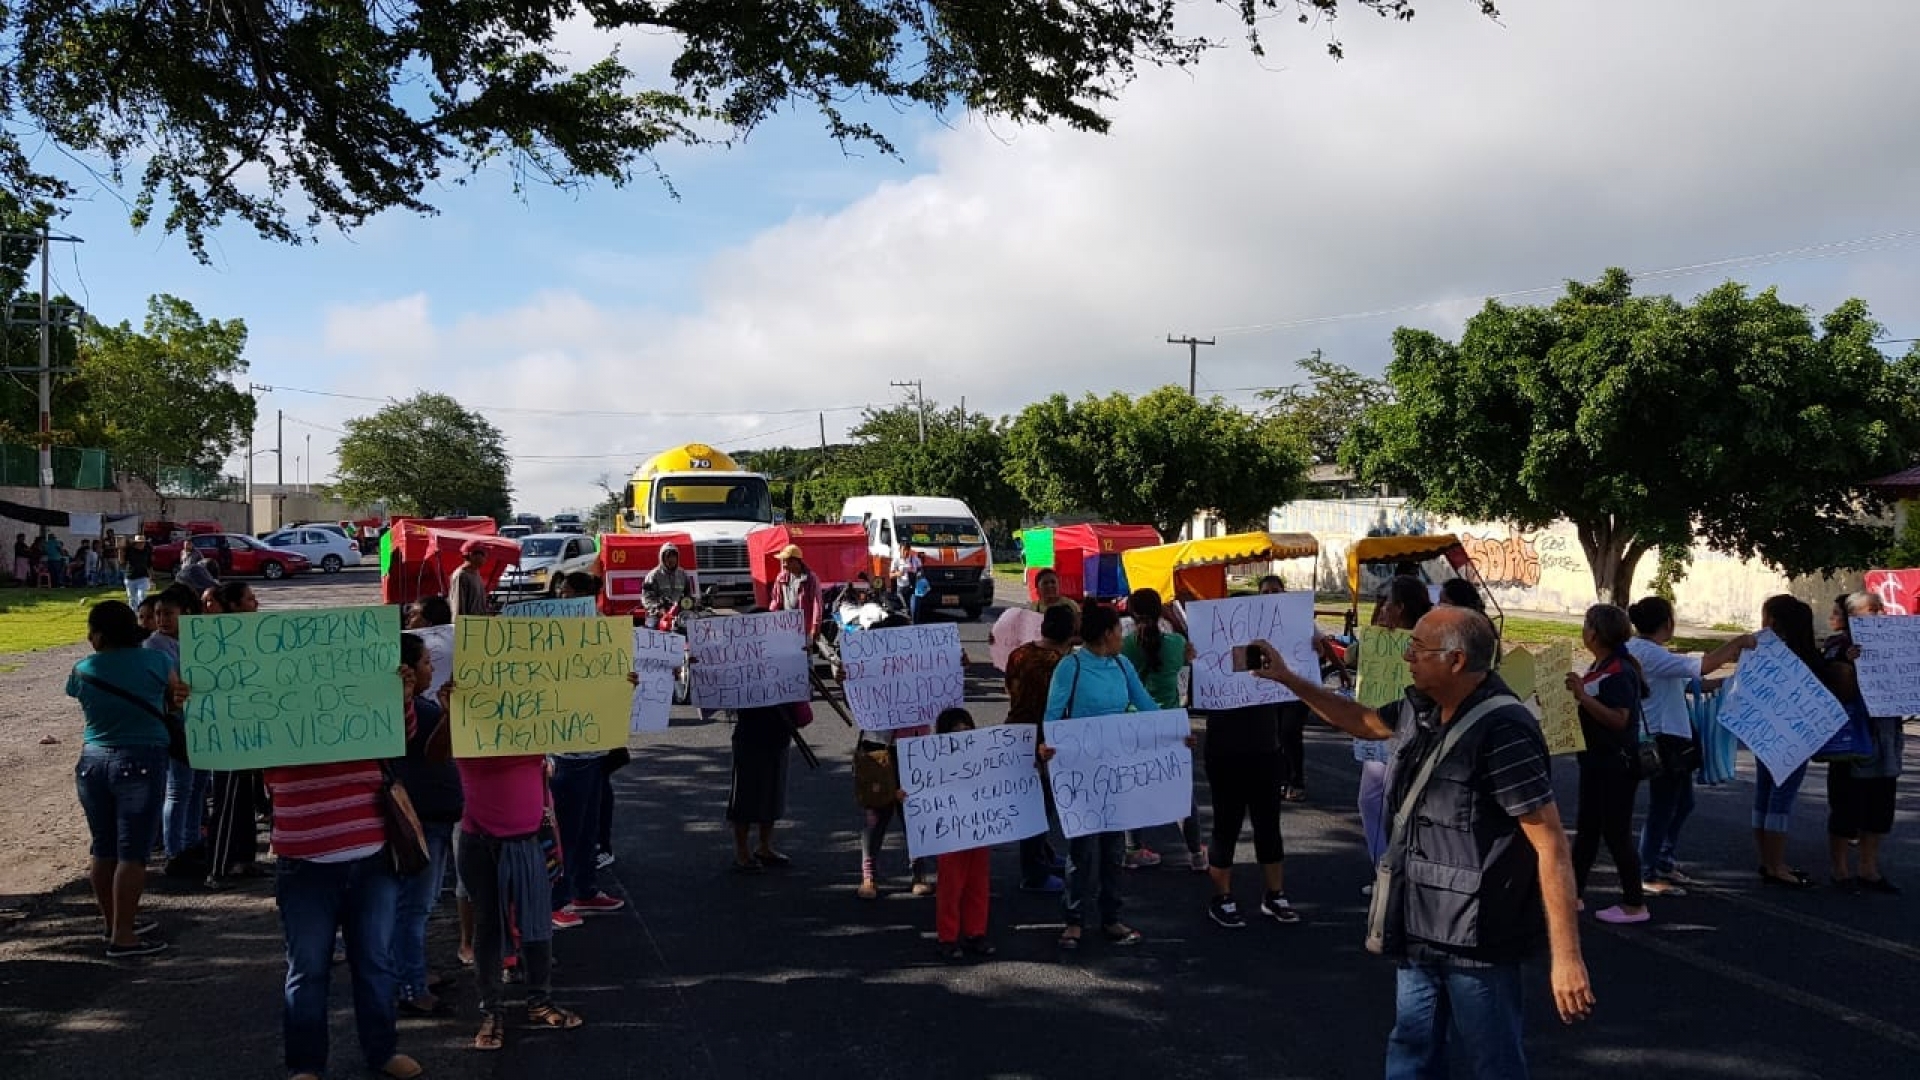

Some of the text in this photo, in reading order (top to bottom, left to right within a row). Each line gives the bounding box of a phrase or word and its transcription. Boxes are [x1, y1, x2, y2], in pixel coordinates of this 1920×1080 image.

[692, 459, 711, 469] 70
[611, 549, 627, 564] 09
[191, 616, 246, 664] SR
[460, 617, 565, 658] FUERA
[580, 619, 613, 649] LA
[1211, 600, 1284, 645] AGUA
[843, 630, 913, 659] SOMOS
[185, 641, 399, 694] DOR QUEREMOS
[458, 647, 631, 690] SUPERVISORA
[692, 663, 780, 686] NUESTRAS
[845, 649, 950, 681] DE FAMILIA
[185, 684, 366, 723] LA ESC DE
[461, 689, 568, 726] ISABEL
[191, 723, 222, 753] LA
[285, 706, 394, 748] VISION
[475, 711, 601, 751] LAGUNAS
[907, 735, 976, 771] FUERA
[906, 794, 959, 818] SORA
[1064, 803, 1117, 836] DOR
[917, 824, 927, 848] Y
[972, 818, 1014, 841] NAVA
